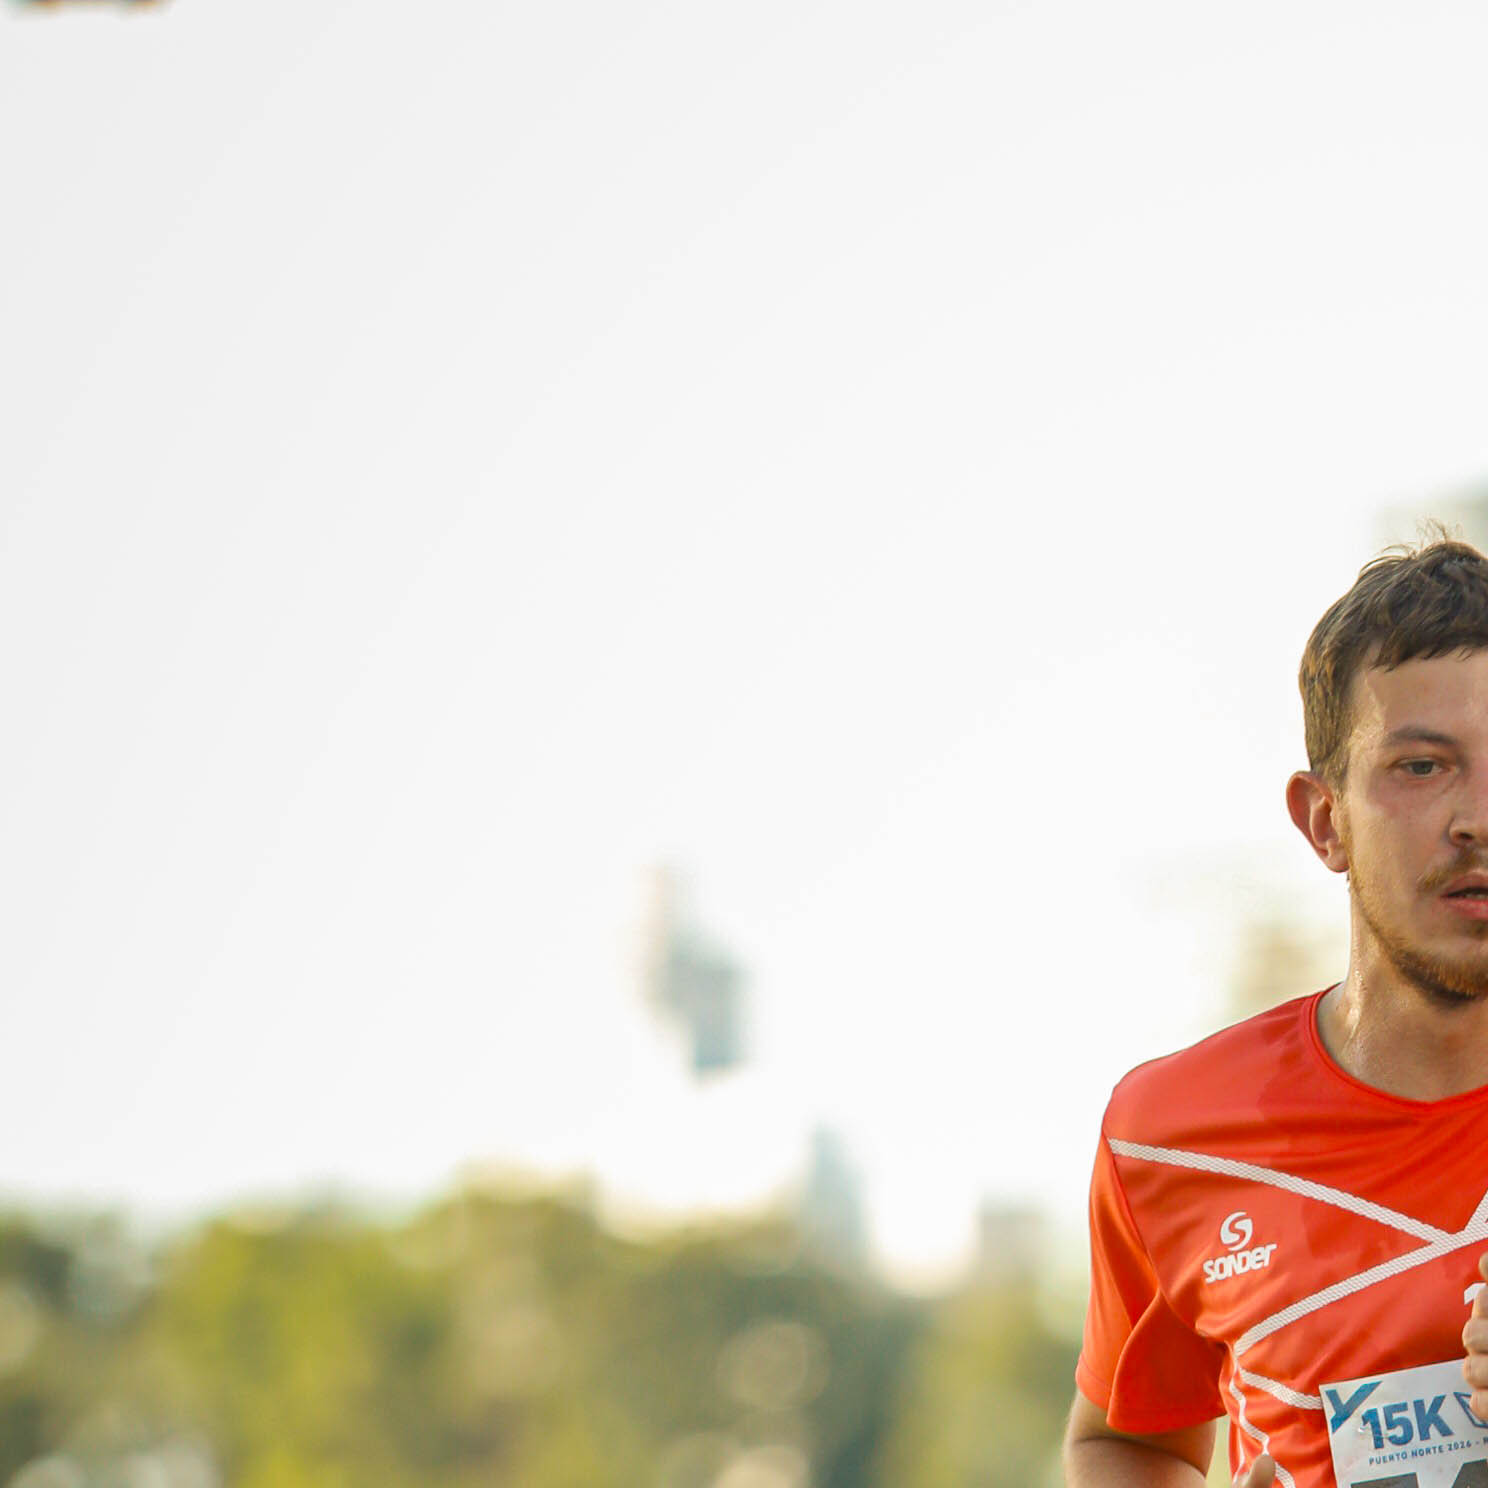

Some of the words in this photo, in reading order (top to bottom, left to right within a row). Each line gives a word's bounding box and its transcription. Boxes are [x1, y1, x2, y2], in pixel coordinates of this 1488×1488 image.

[1361, 1394, 1454, 1450] 15K
[1368, 1452, 1407, 1465] PUERTO
[1411, 1447, 1444, 1458] NORTE
[1447, 1440, 1472, 1452] 2026
